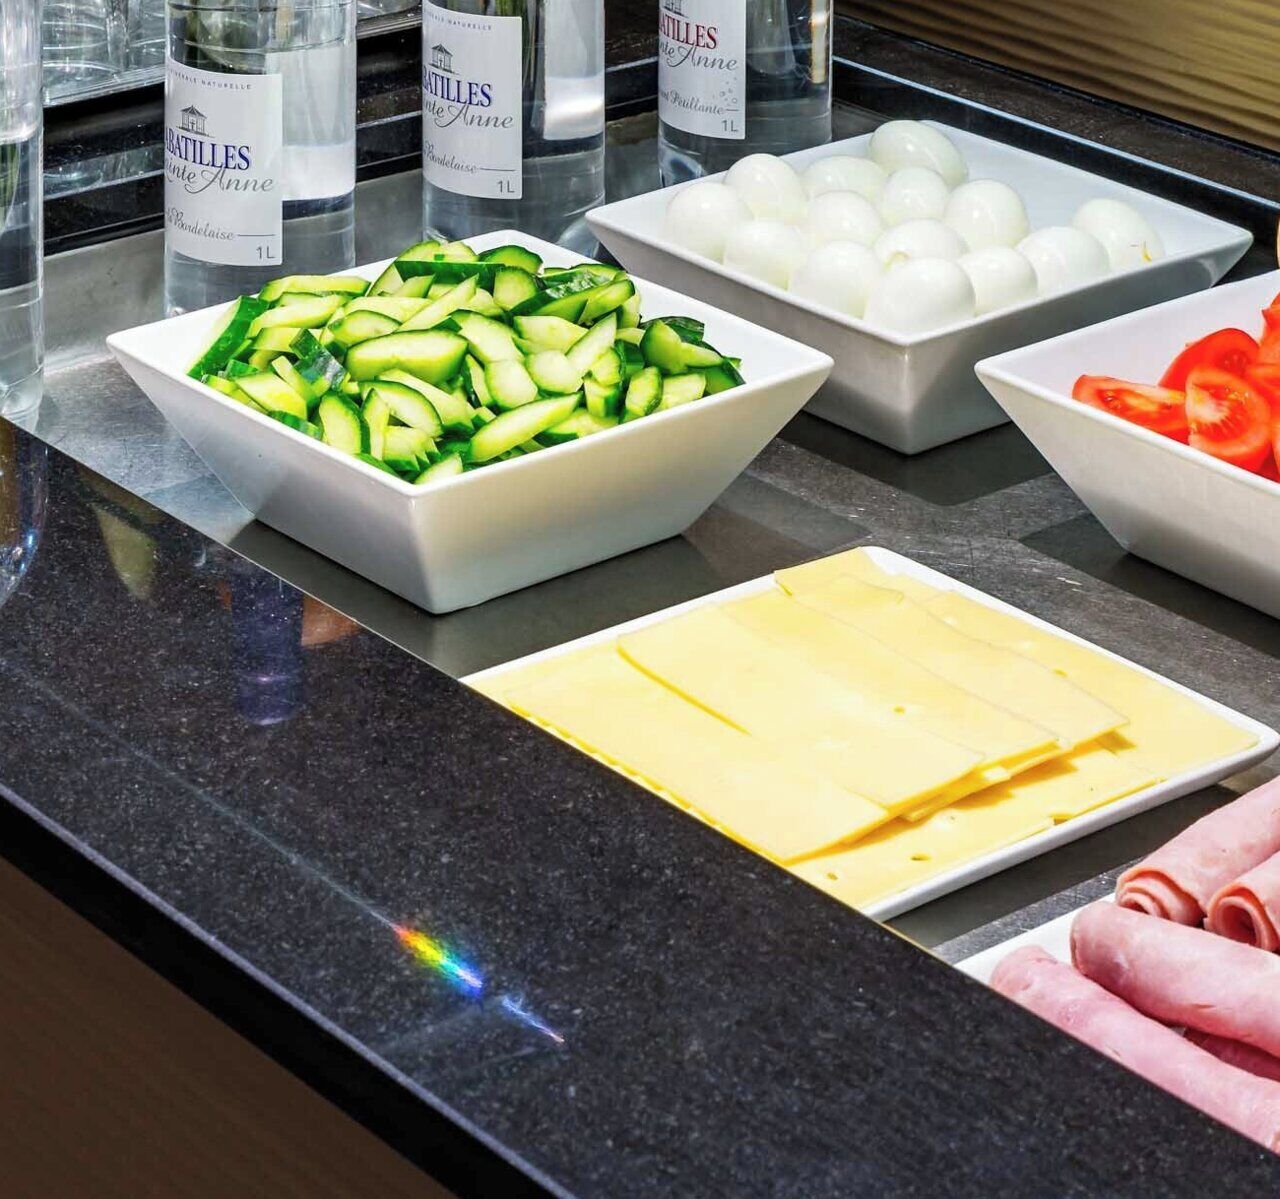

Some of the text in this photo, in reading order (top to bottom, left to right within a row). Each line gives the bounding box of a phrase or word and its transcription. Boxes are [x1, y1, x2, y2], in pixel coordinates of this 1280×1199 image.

[667, 45, 738, 71] Anne
[434, 103, 514, 129] Anne
[184, 168, 274, 194] Anne
